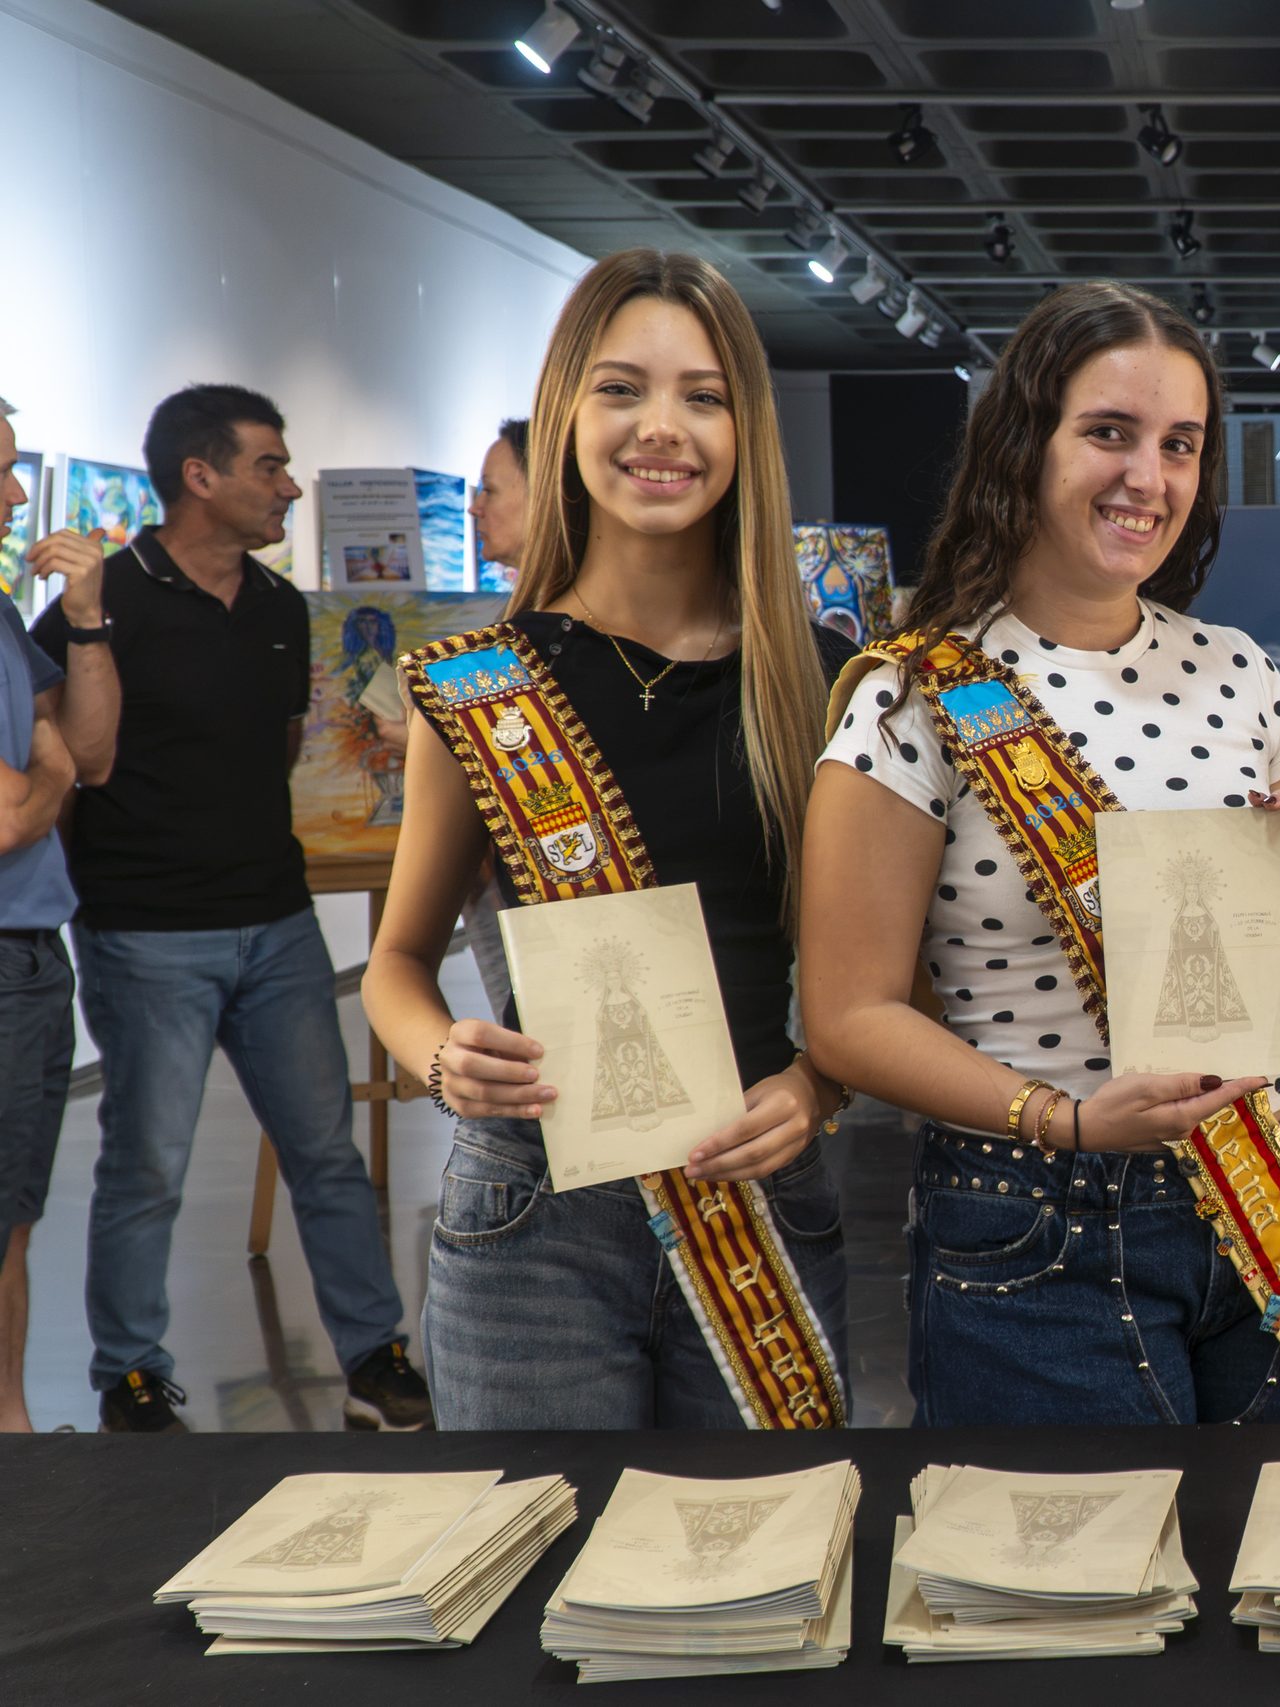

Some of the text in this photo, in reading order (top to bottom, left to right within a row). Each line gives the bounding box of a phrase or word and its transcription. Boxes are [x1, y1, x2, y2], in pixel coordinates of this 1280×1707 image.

[496, 749, 565, 784] 2026
[1024, 791, 1084, 831] 2026
[1200, 1104, 1280, 1238] Reina
